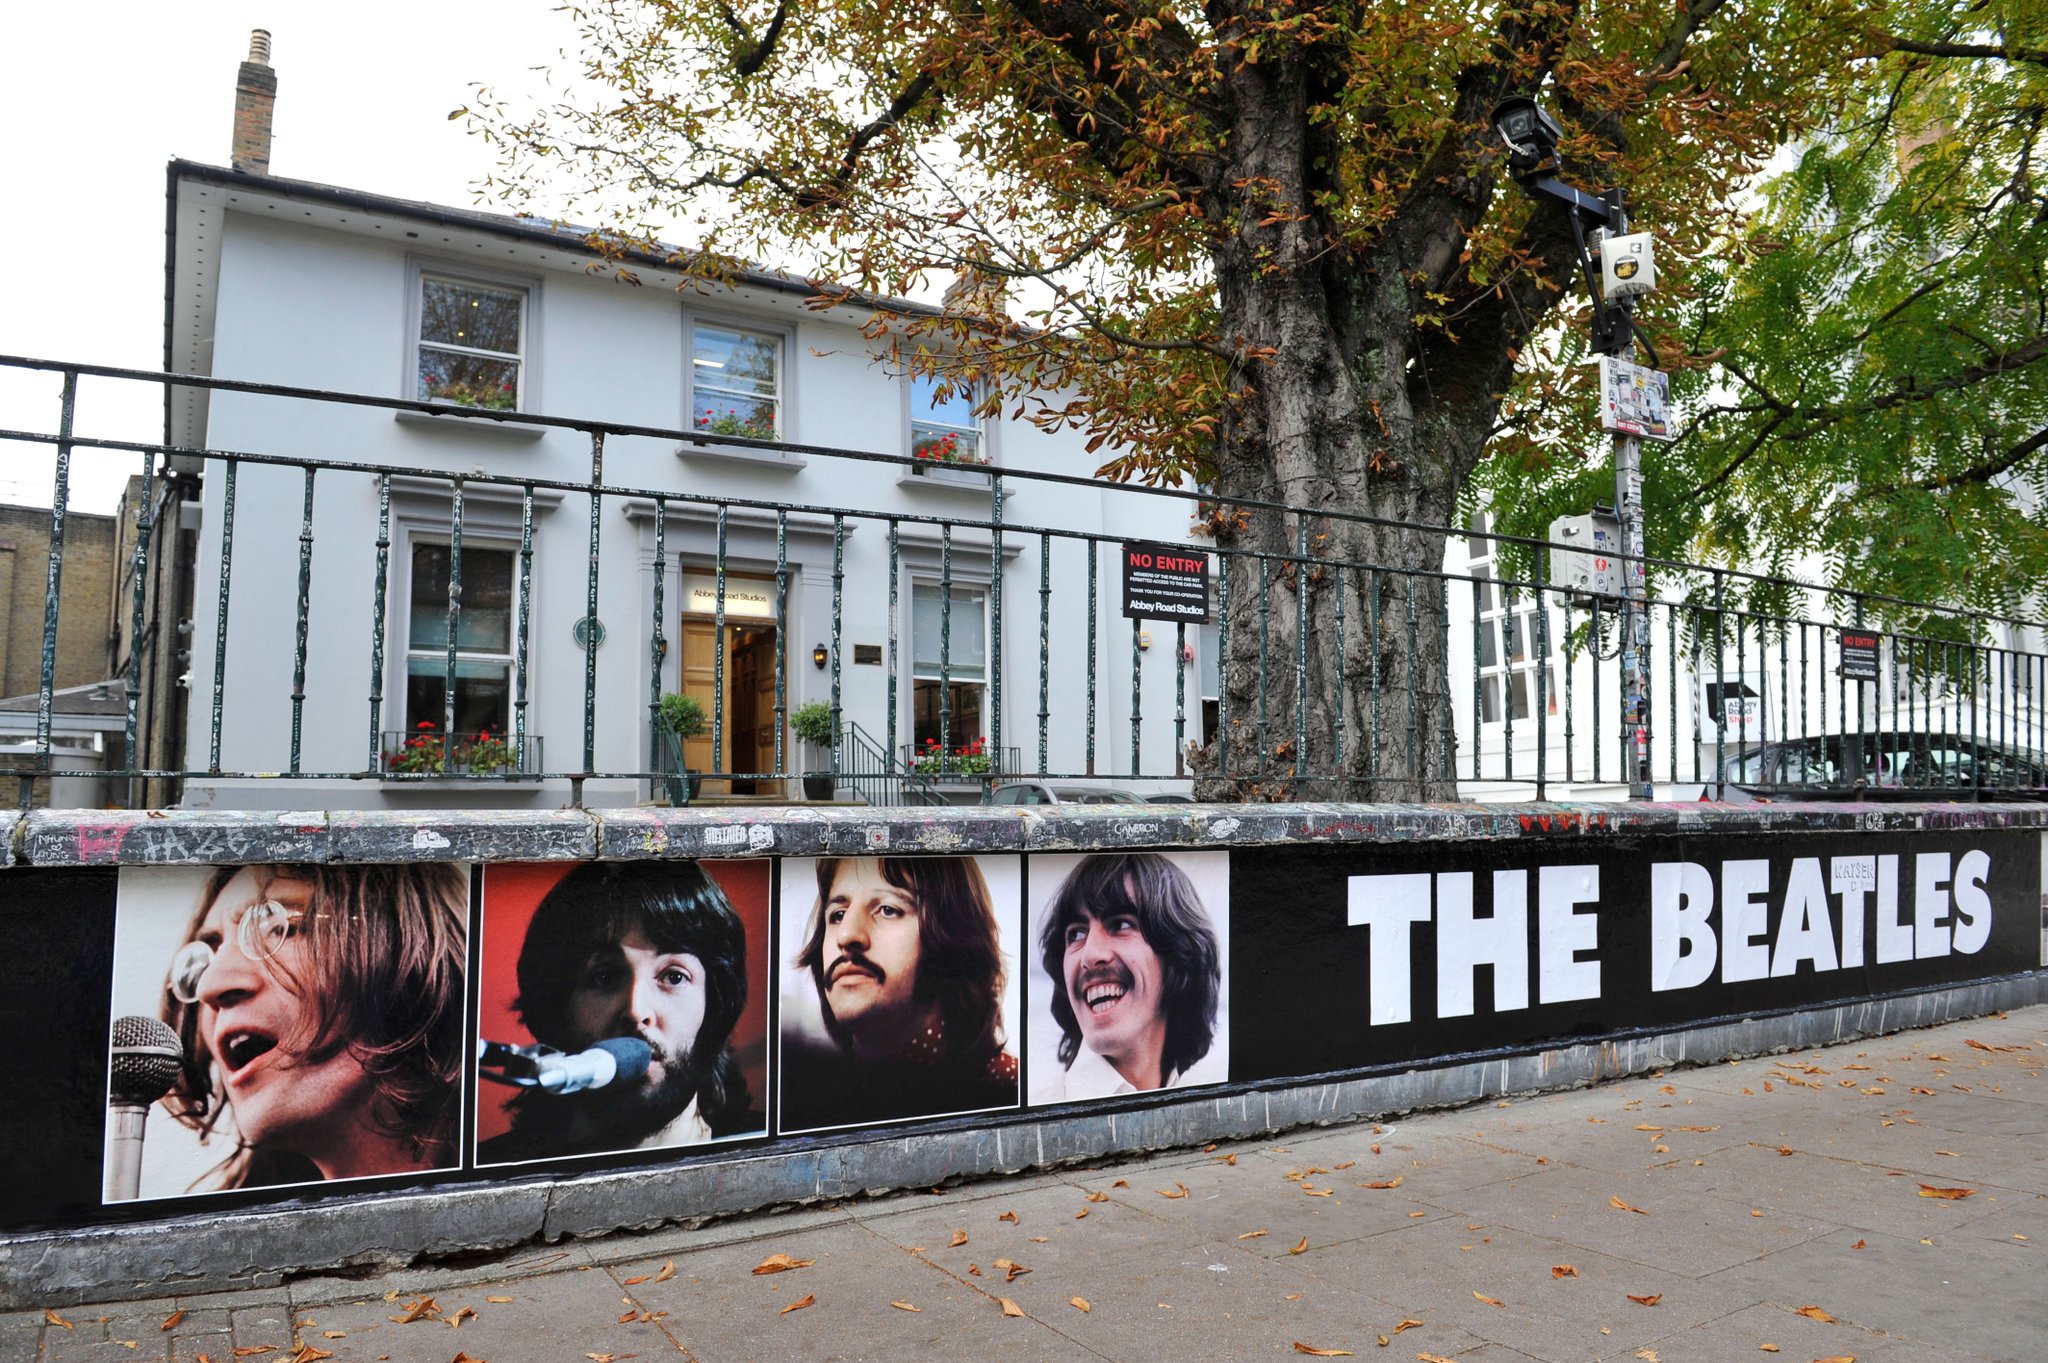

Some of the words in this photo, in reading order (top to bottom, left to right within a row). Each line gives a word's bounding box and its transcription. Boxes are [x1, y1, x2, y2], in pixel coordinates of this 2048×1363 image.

[1130, 553, 1152, 568] NO
[1156, 556, 1203, 573] ENTRY
[719, 592, 739, 600] oad
[740, 592, 767, 602] Studios
[1130, 600, 1155, 612] Abbey
[1156, 602, 1176, 612] Road
[1177, 604, 1204, 615] Studios
[1728, 707, 1752, 716] Rod
[1728, 716, 1752, 724] Shp
[1114, 823, 1159, 836] CAMERON
[1348, 865, 1600, 1027] THE
[1651, 850, 1992, 993] BEATLES
